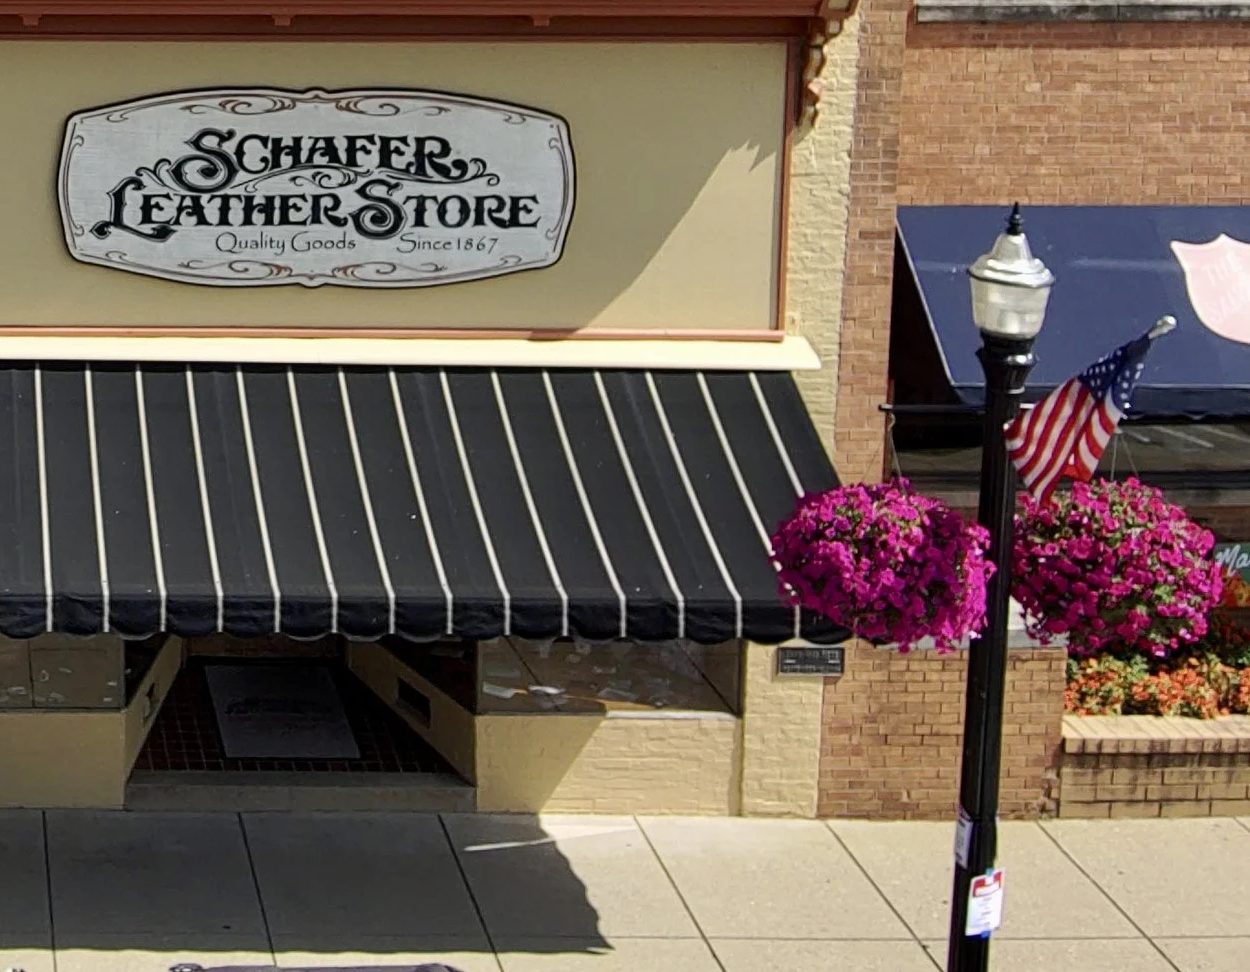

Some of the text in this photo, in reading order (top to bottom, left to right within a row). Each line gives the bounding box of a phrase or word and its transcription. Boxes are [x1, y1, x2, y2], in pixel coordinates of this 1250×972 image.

[168, 128, 474, 193] SCHAFER
[90, 176, 542, 243] LEATHER STORE
[214, 230, 357, 256] Quality Goods
[395, 231, 499, 254] Since 1867
